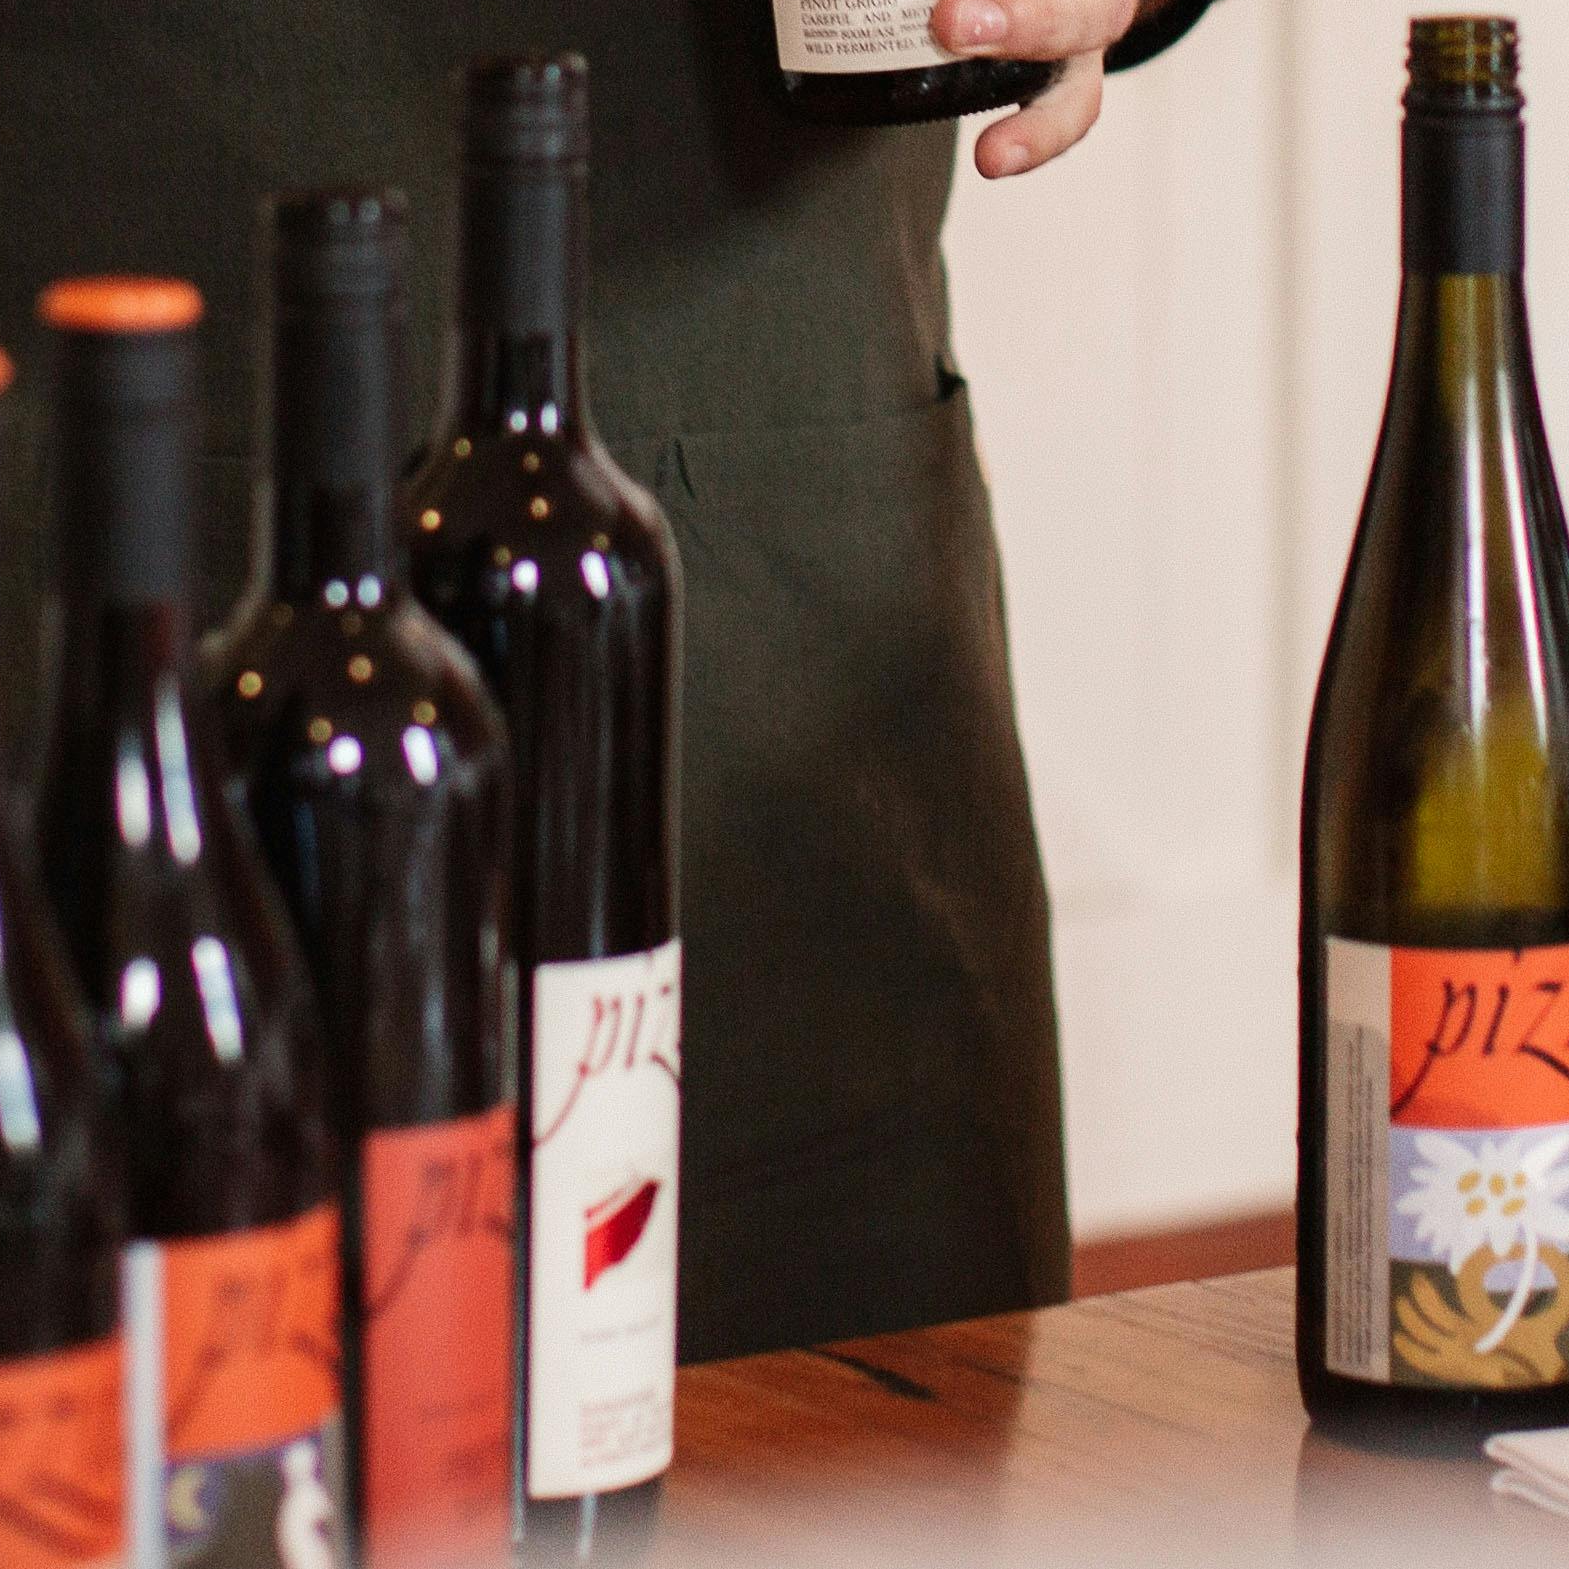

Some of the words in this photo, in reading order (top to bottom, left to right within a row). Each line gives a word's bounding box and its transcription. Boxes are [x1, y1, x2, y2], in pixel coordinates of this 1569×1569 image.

[800, 11, 852, 27] CAREFUL
[863, 10, 893, 26] AND
[804, 41, 834, 56] WILD
